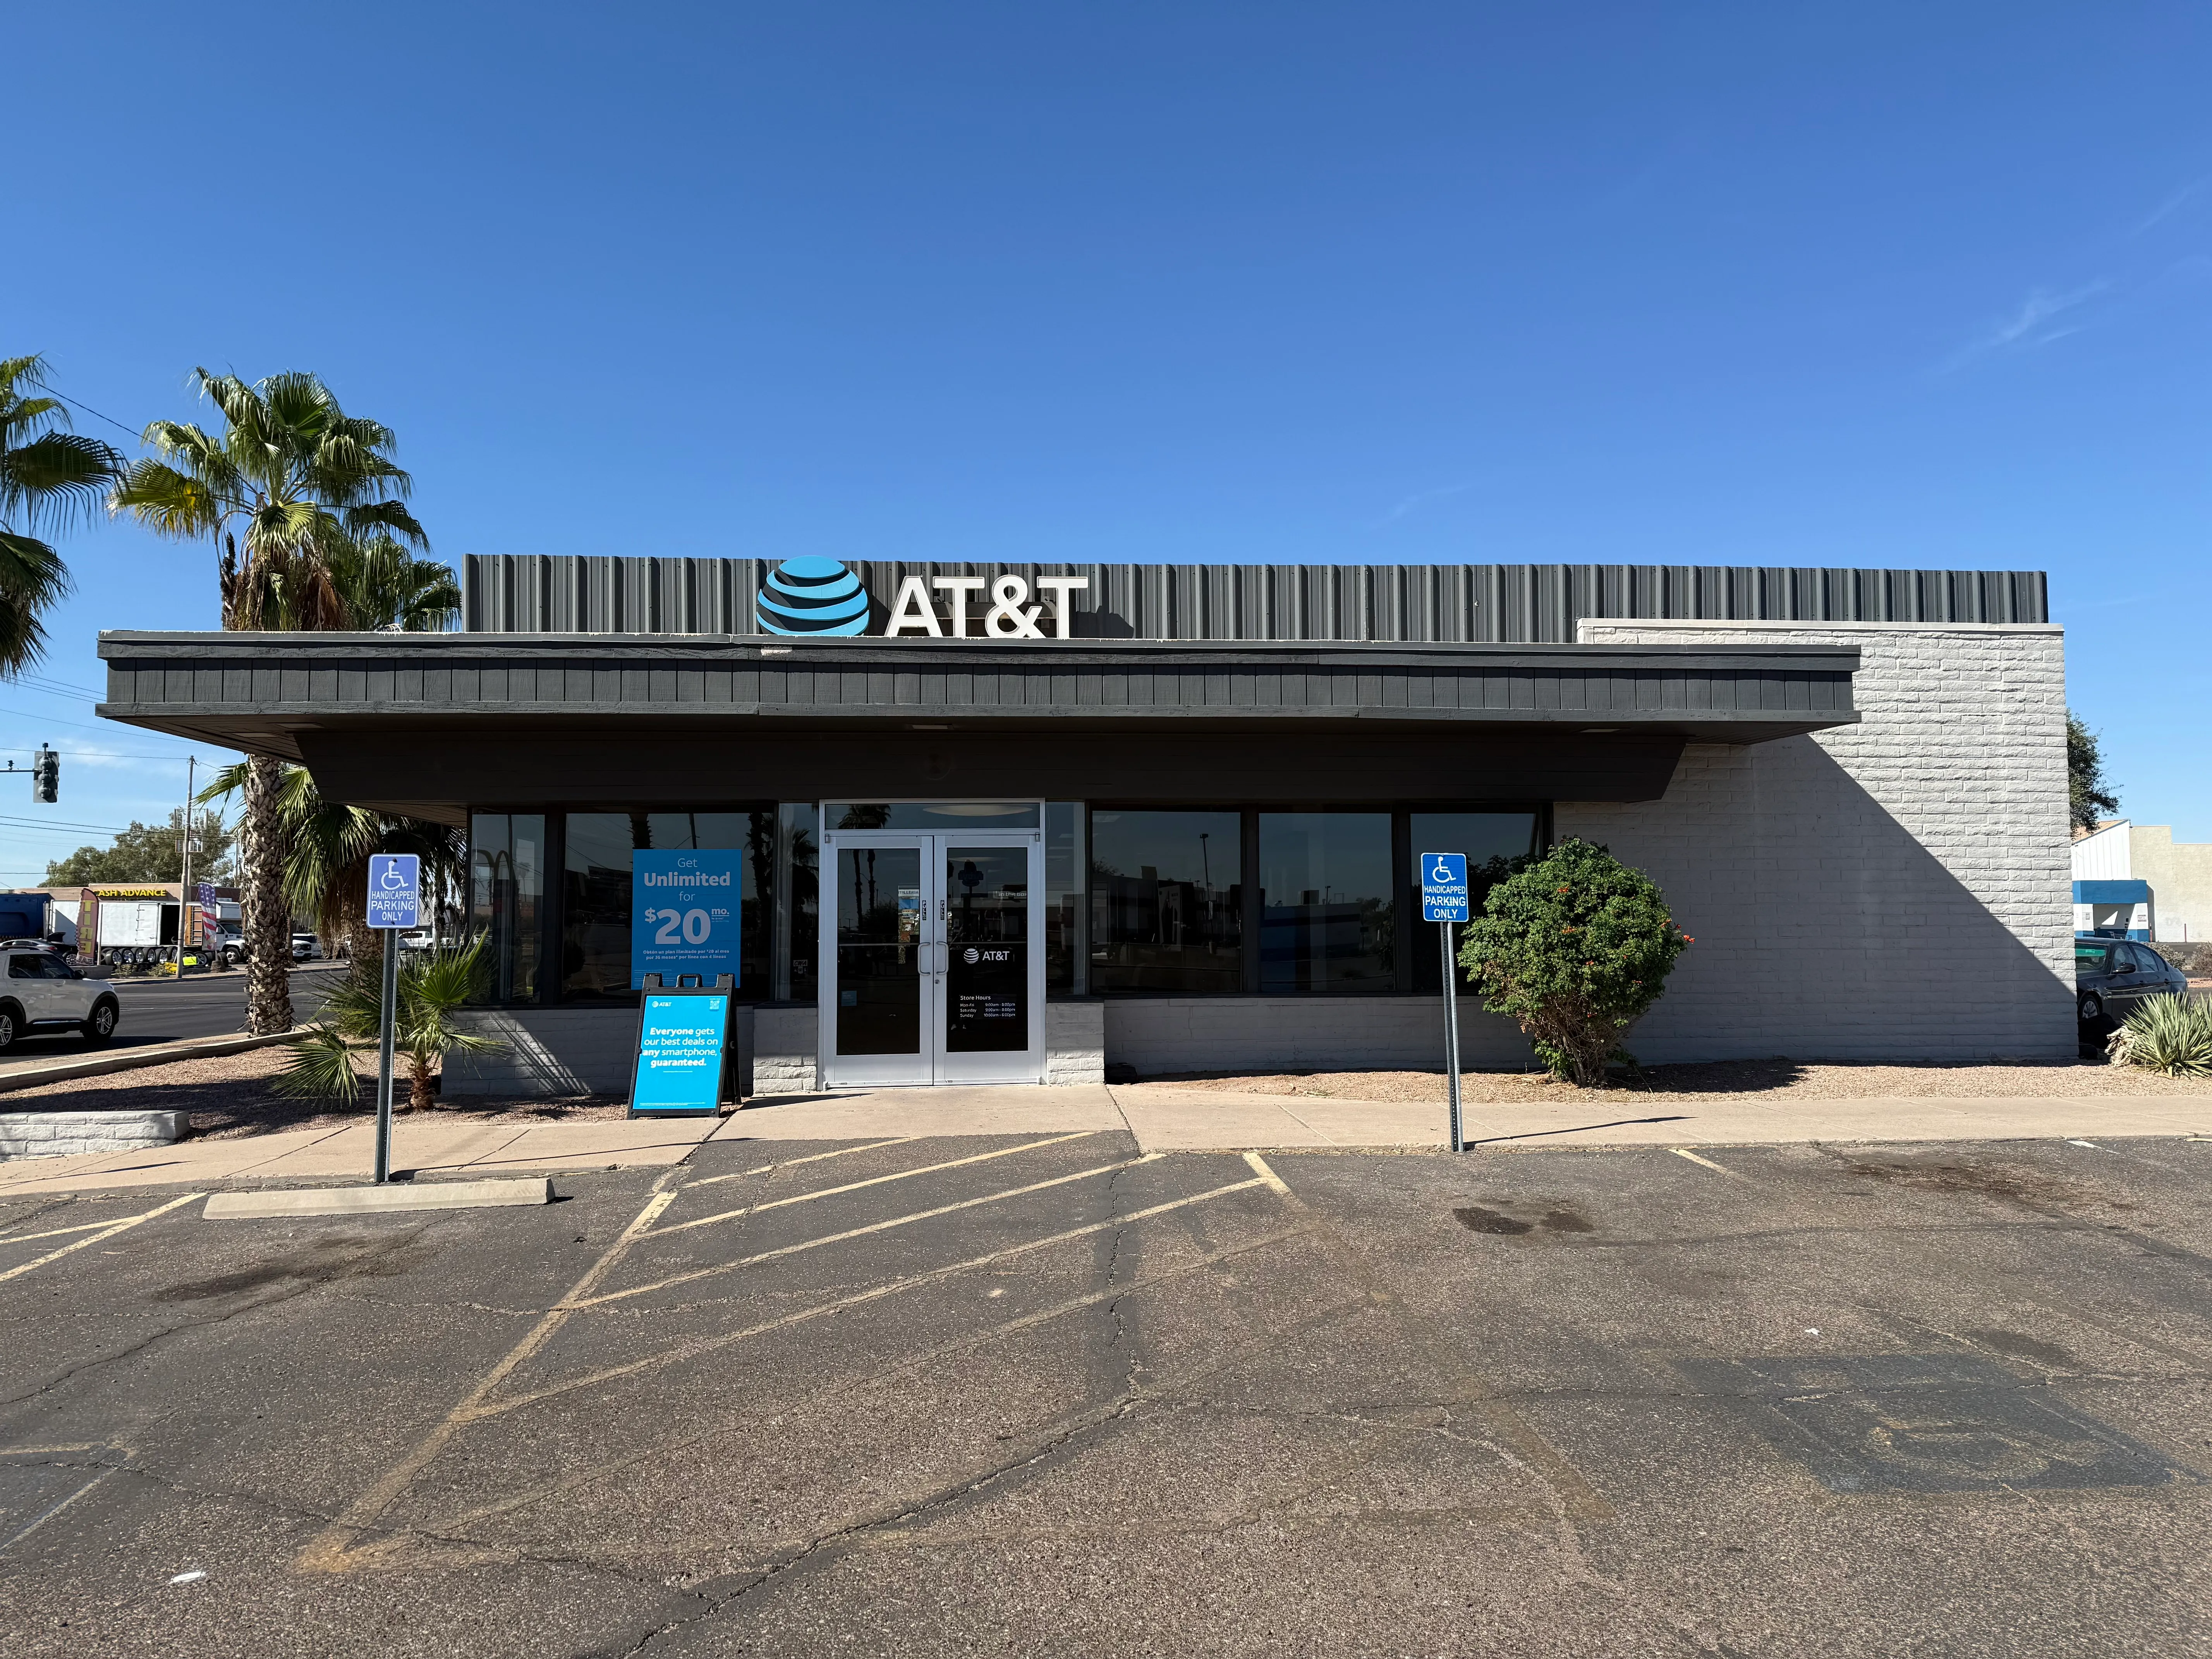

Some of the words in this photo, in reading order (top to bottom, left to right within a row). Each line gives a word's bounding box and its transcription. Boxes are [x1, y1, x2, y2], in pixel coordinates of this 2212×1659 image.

[884, 574, 1089, 639] AT&T
[678, 858, 697, 867] Get
[644, 872, 730, 886] Unlimited
[1424, 885, 1466, 894] HANDICAPPED
[372, 891, 414, 899] HANDICAPPED
[679, 891, 696, 901] for
[371, 901, 414, 910] PARKING
[1425, 896, 1466, 906] PARKING
[382, 912, 403, 921] ONLY
[1434, 908, 1458, 919] ONLY
[644, 907, 711, 944] $20
[982, 951, 1010, 961] AT&T
[649, 1027, 694, 1037] Everyone
[696, 1028, 715, 1037] gets
[661, 1037, 681, 1045] best
[682, 1037, 705, 1045] deals
[642, 1049, 660, 1058] any
[661, 1048, 717, 1057] smartphone,
[650, 1058, 707, 1068] guaranteed.
